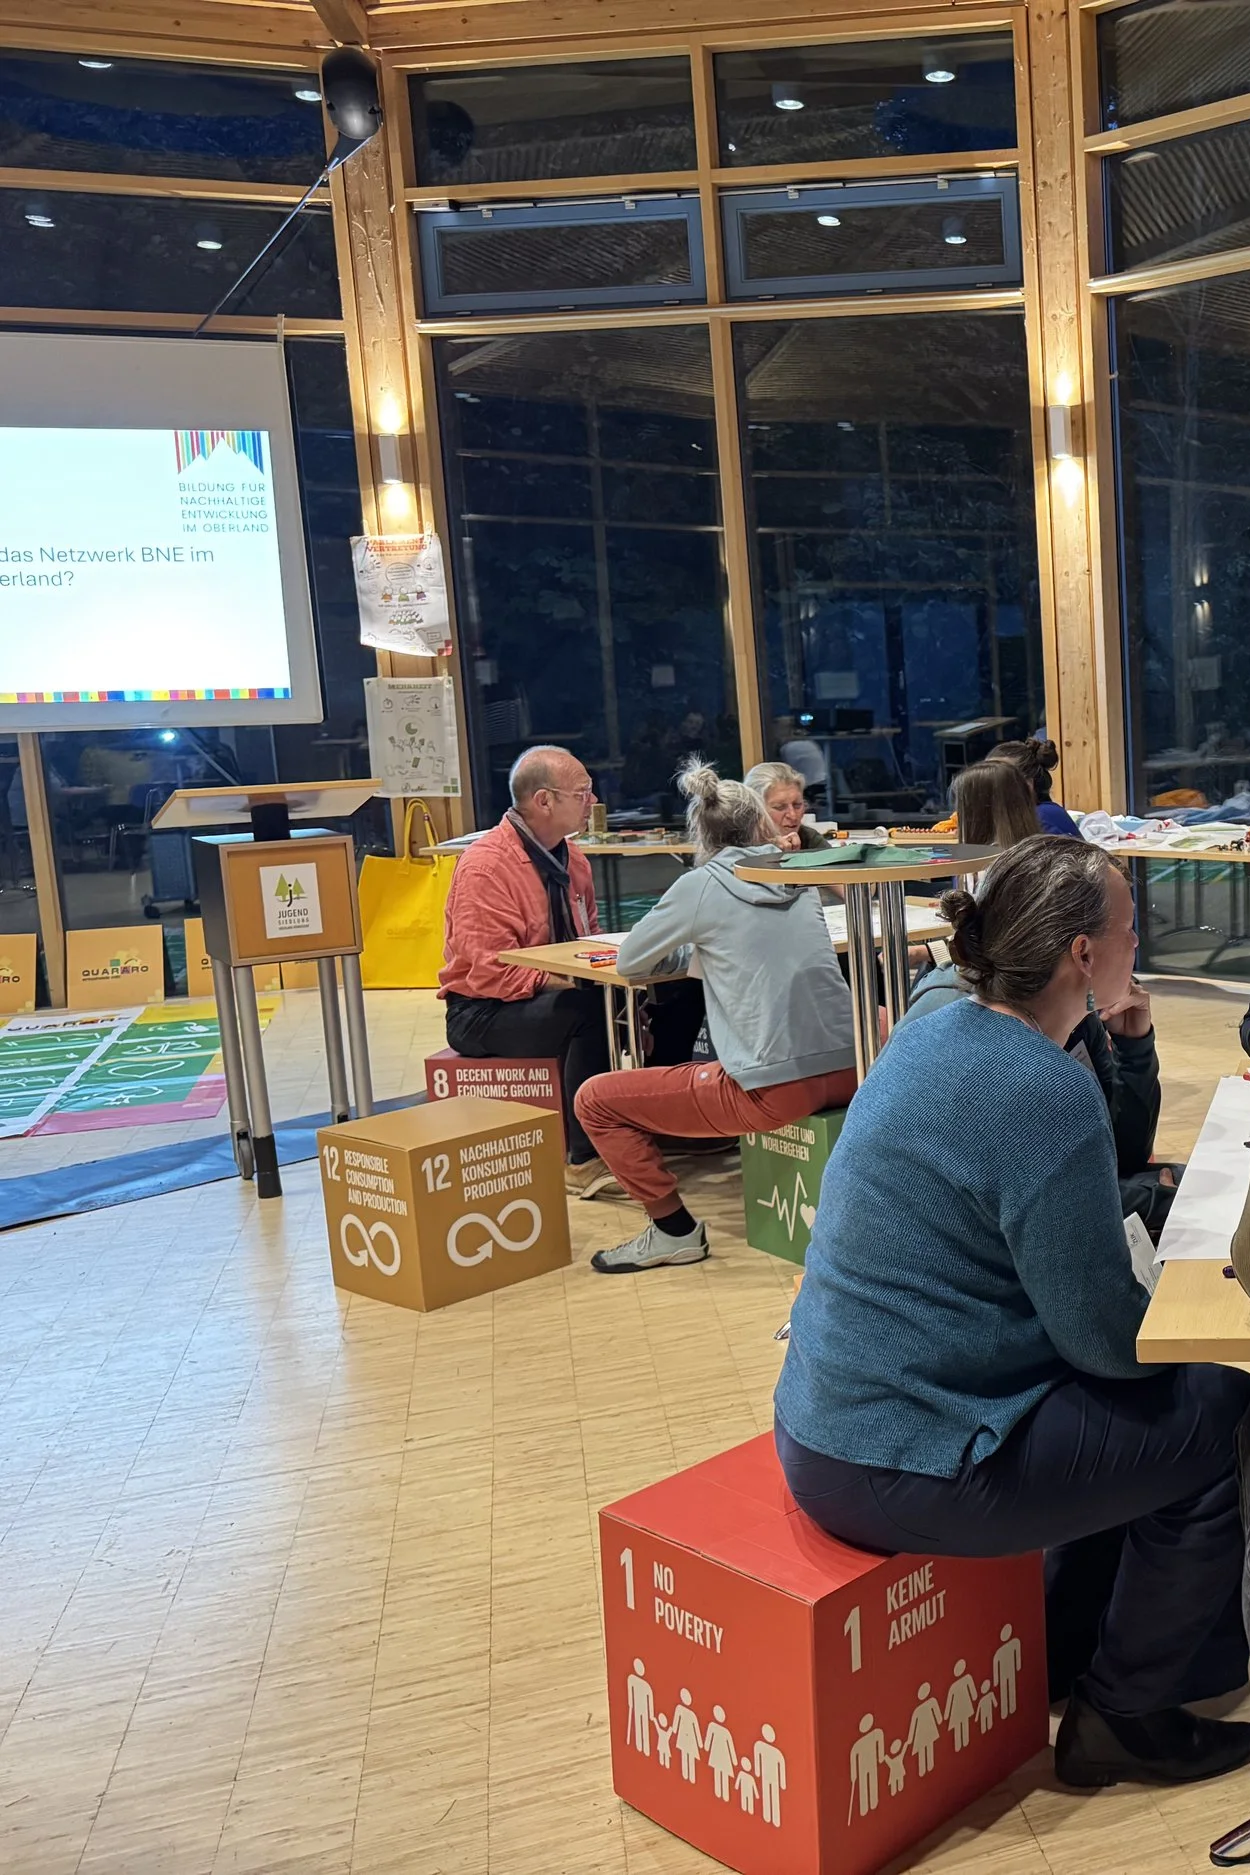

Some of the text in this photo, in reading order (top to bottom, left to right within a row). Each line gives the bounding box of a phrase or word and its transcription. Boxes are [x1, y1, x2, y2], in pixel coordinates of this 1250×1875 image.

[178, 482, 235, 492] BILDUNG
[180, 496, 266, 506] NACHHALTIGE
[181, 509, 268, 519] ENTWICKLUNG
[182, 523, 269, 533] IM OBERLAND
[0, 546, 215, 563] das Netzwerk BNE im
[278, 908, 309, 918] JUGEND
[433, 1068, 549, 1098] 8 DECENT WORK AND
[457, 1083, 554, 1098] ECONOMIC GROWTH
[761, 1134, 810, 1162] WOHLERGEHEN
[800, 1127, 816, 1145] UND
[322, 1144, 389, 1182] 12 RESPONSIBLE
[421, 1128, 544, 1193] 12 NACHHALTIGE/R
[461, 1151, 532, 1184] KONSUM UND
[345, 1168, 395, 1195] CONSUMPTION
[463, 1169, 533, 1203] PRODUKTION
[348, 1187, 408, 1217] AND PRODUCTION
[619, 1547, 675, 1611] 1 NO
[654, 1596, 724, 1654] POVERTY
[843, 1561, 935, 1673] 1 KEINE
[888, 1589, 947, 1650] ARMUT
